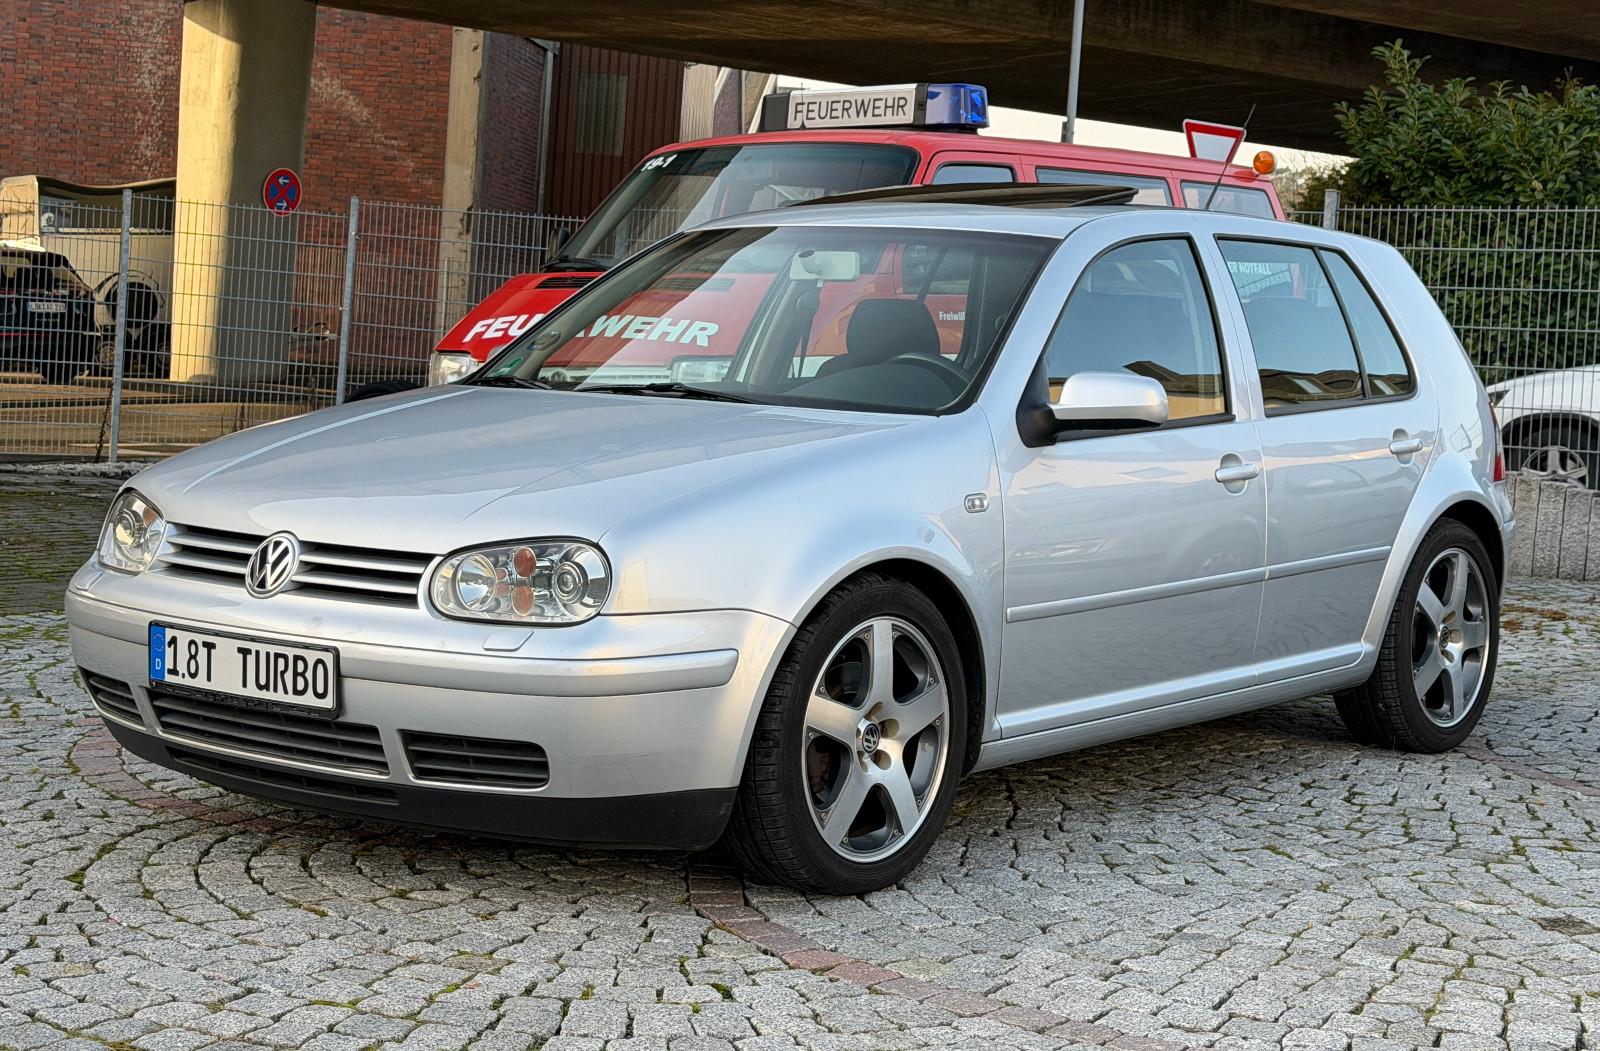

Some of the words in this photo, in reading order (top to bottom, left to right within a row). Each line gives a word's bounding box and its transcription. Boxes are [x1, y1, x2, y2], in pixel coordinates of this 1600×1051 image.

[794, 96, 908, 122] FEUERWEHR
[1240, 261, 1272, 275] NOTFALL
[463, 313, 719, 348] FEUWEHR
[247, 534, 297, 594] VW
[155, 657, 162, 671] D
[167, 635, 216, 683] 1.8T
[236, 646, 328, 700] TURBO
